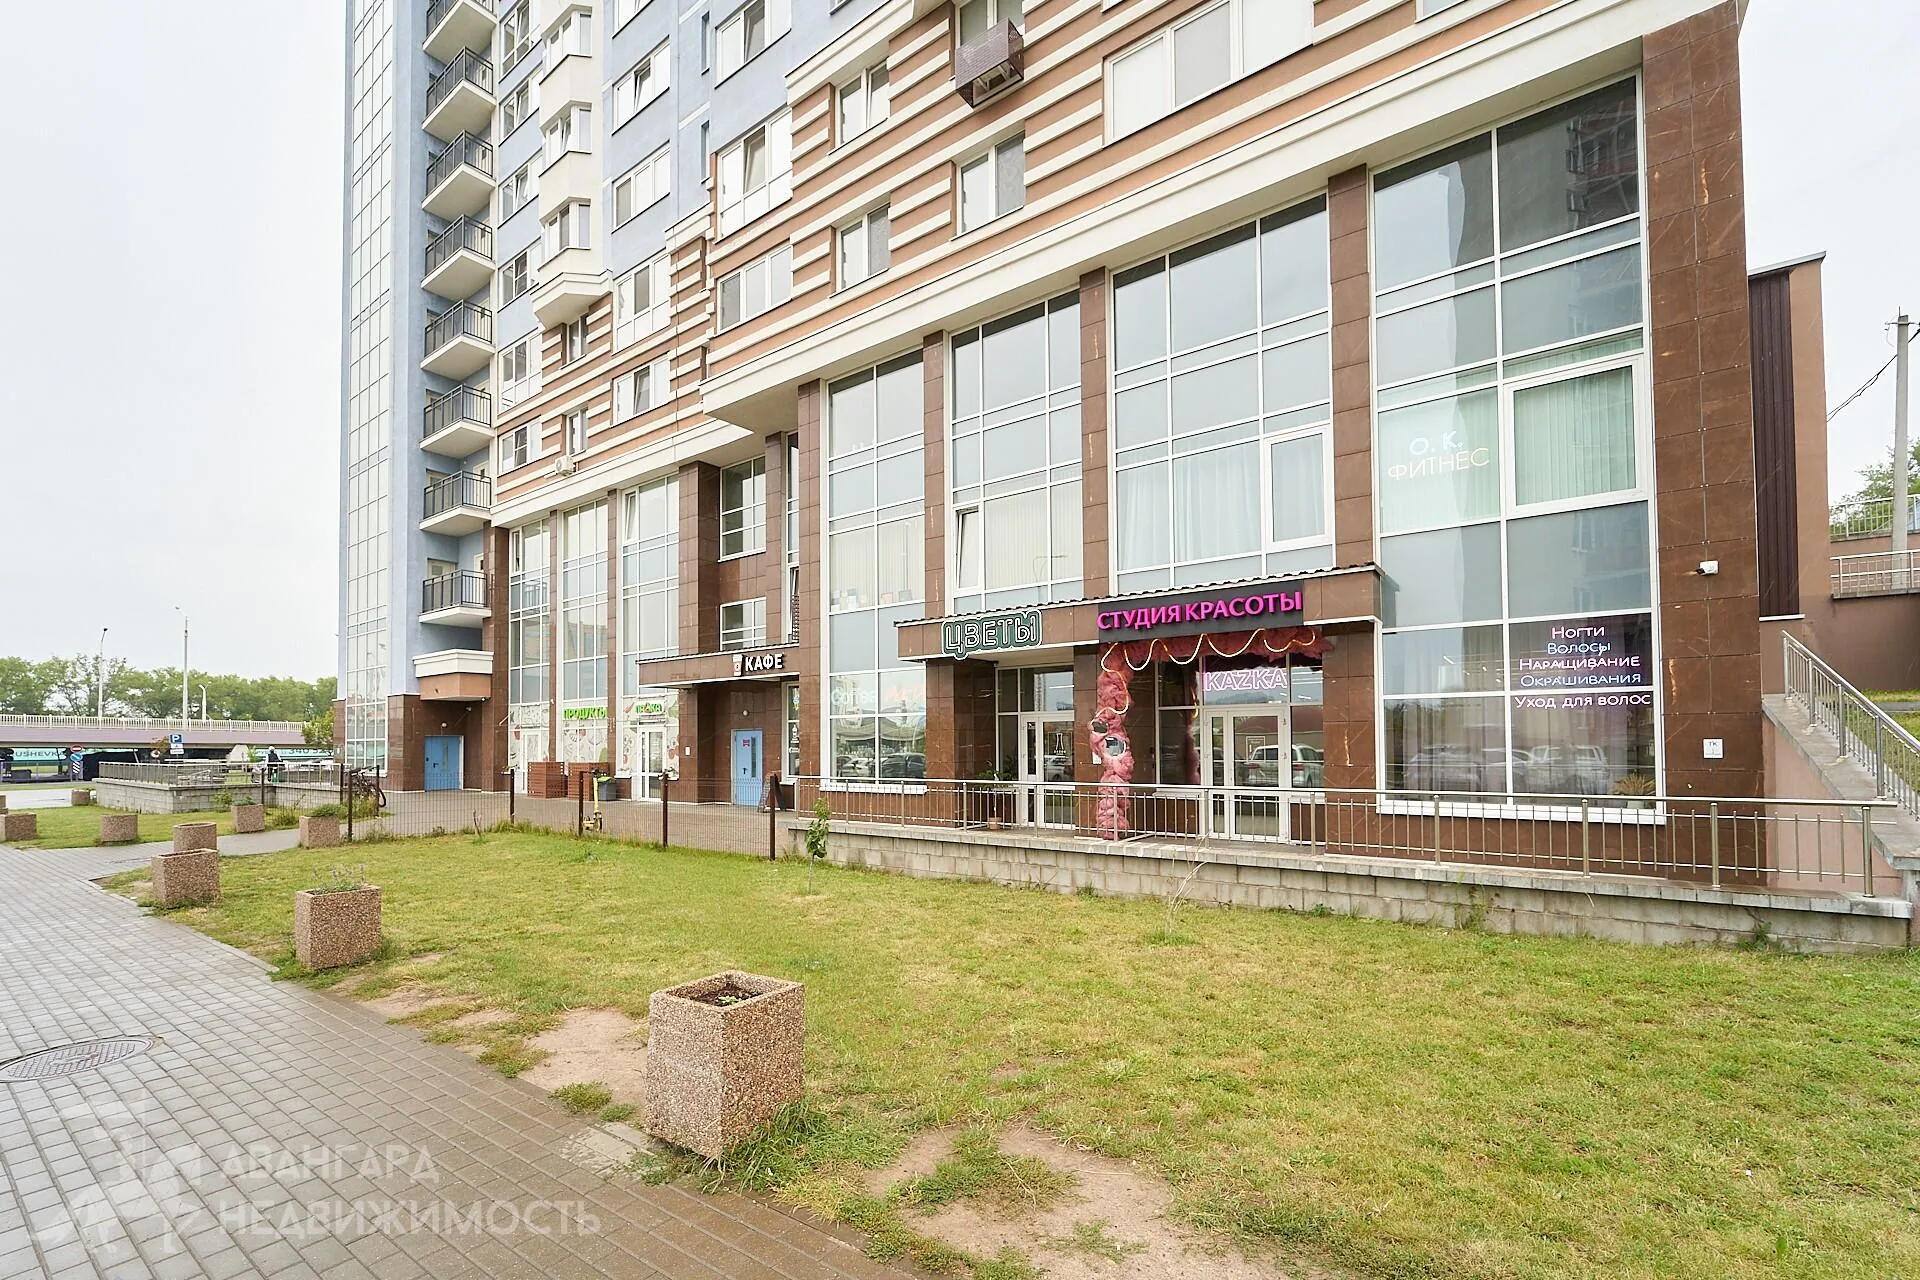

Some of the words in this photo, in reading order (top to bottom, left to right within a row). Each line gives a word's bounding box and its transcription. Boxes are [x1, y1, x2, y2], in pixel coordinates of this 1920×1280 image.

[1387, 447, 1490, 481] ФИТНЕС
[1096, 603, 1182, 631] СТУДИЯ
[1184, 590, 1303, 621] КРАСОТЫ
[944, 611, 1039, 655] ЦВЕТЫ
[744, 653, 784, 672] КАФЕ
[1204, 668, 1288, 691] KAZKA
[563, 706, 608, 720] ПРОДУКТЫ
